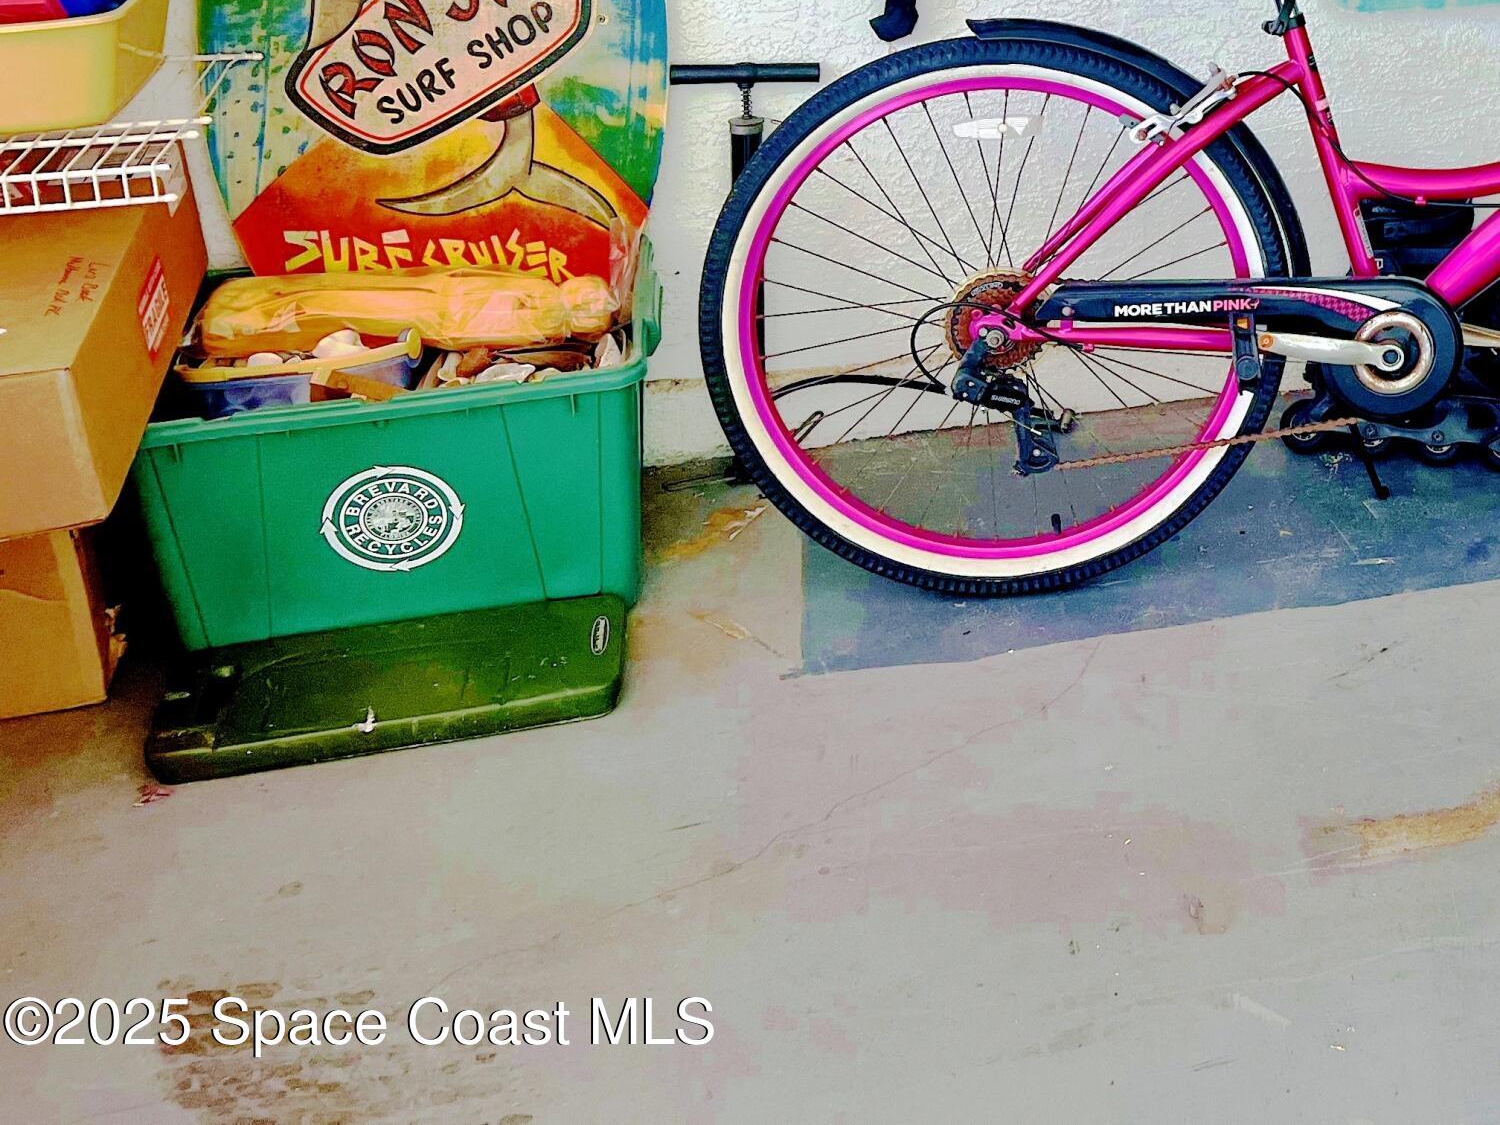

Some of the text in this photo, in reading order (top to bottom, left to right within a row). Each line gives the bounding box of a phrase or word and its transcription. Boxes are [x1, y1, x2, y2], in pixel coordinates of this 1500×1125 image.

[376, 1, 553, 124] SURF SHOP
[283, 228, 575, 284] SURF CRUISER
[1114, 298, 1251, 318] MORE THAN PINK
[345, 481, 438, 516] BREVARD
[345, 516, 443, 555] RECYCLES
